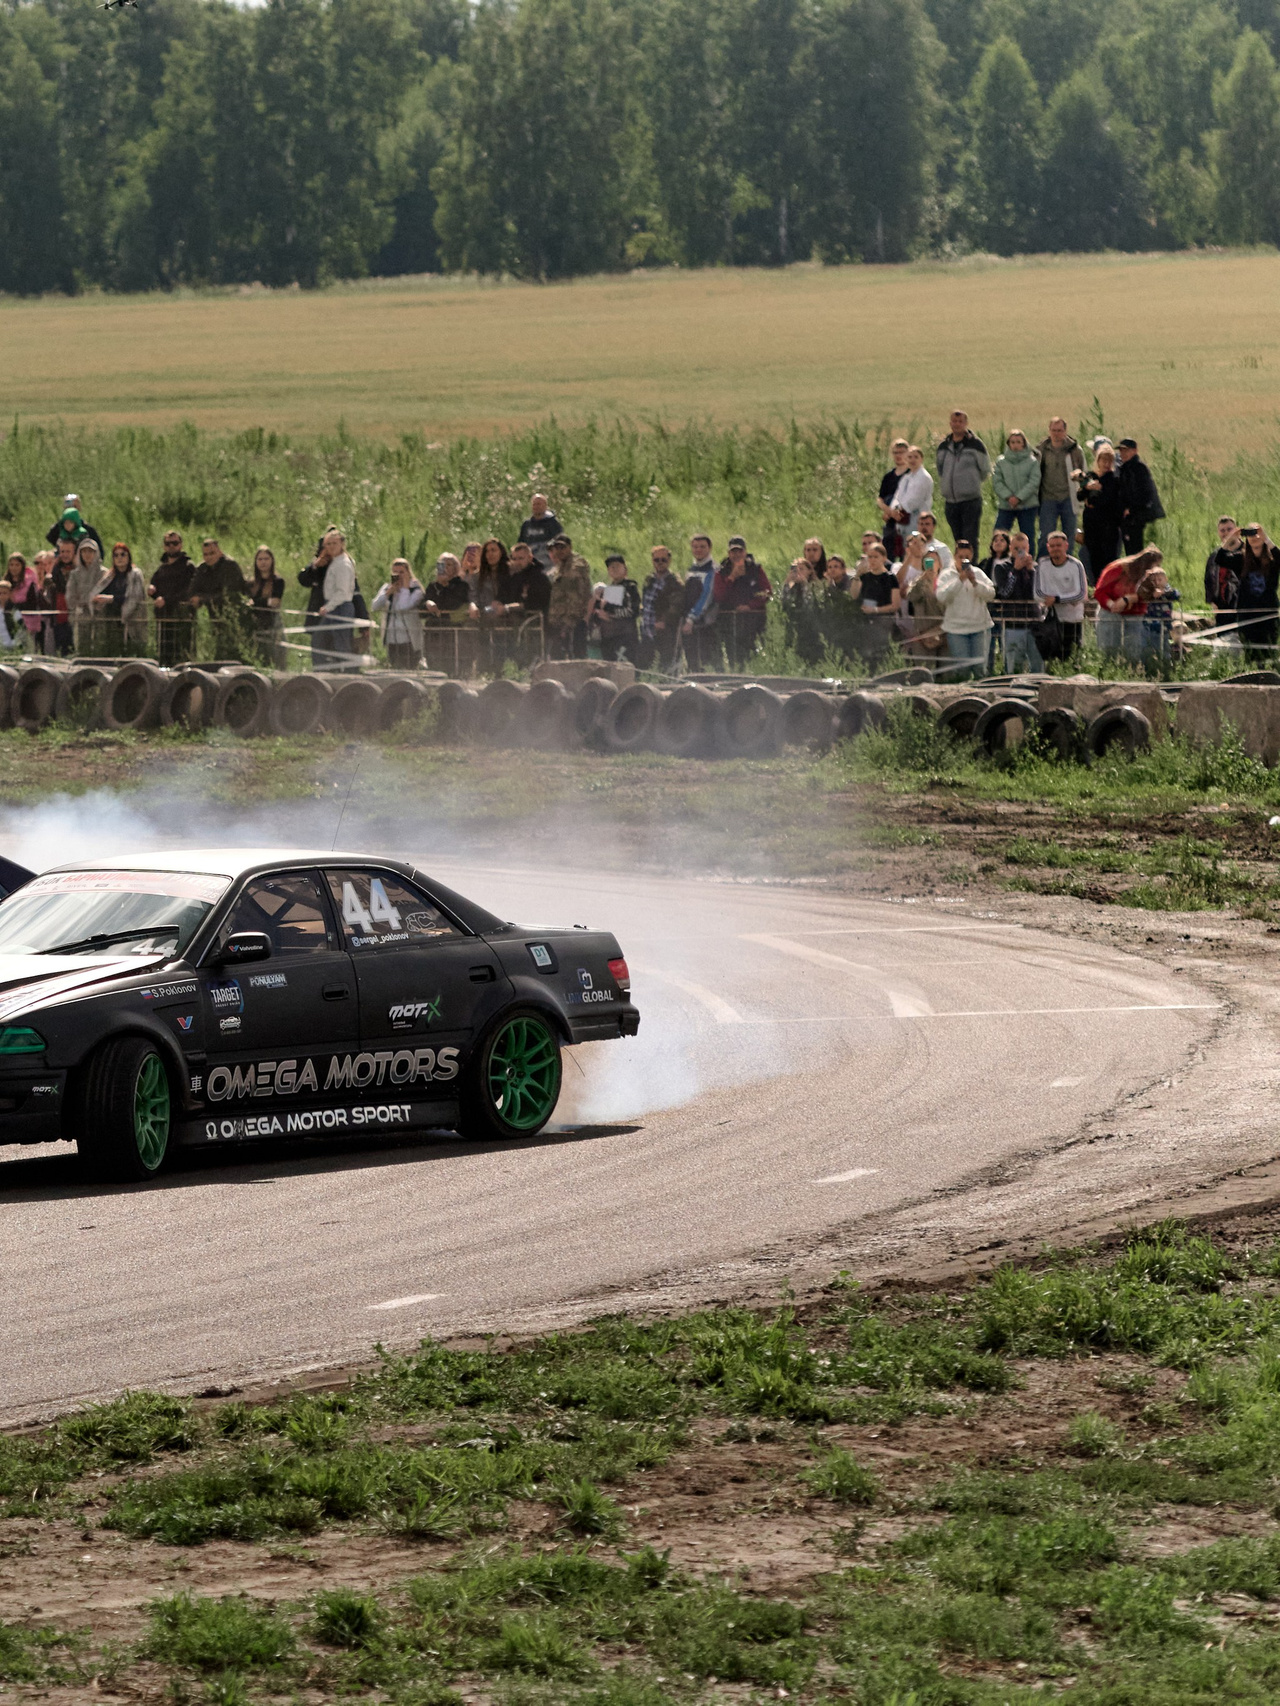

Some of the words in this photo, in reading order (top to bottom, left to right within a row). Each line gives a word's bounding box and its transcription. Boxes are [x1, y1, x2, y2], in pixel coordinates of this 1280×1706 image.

[342, 878, 403, 934] 44
[131, 938, 180, 958] 44
[151, 984, 197, 999] S.Poklonov
[210, 986, 240, 1003] TARGET
[207, 1058, 318, 1101] OMEGA
[323, 1047, 460, 1090] MOTORS
[287, 1109, 349, 1132] MOTOR
[351, 1105, 412, 1125] SPORT
